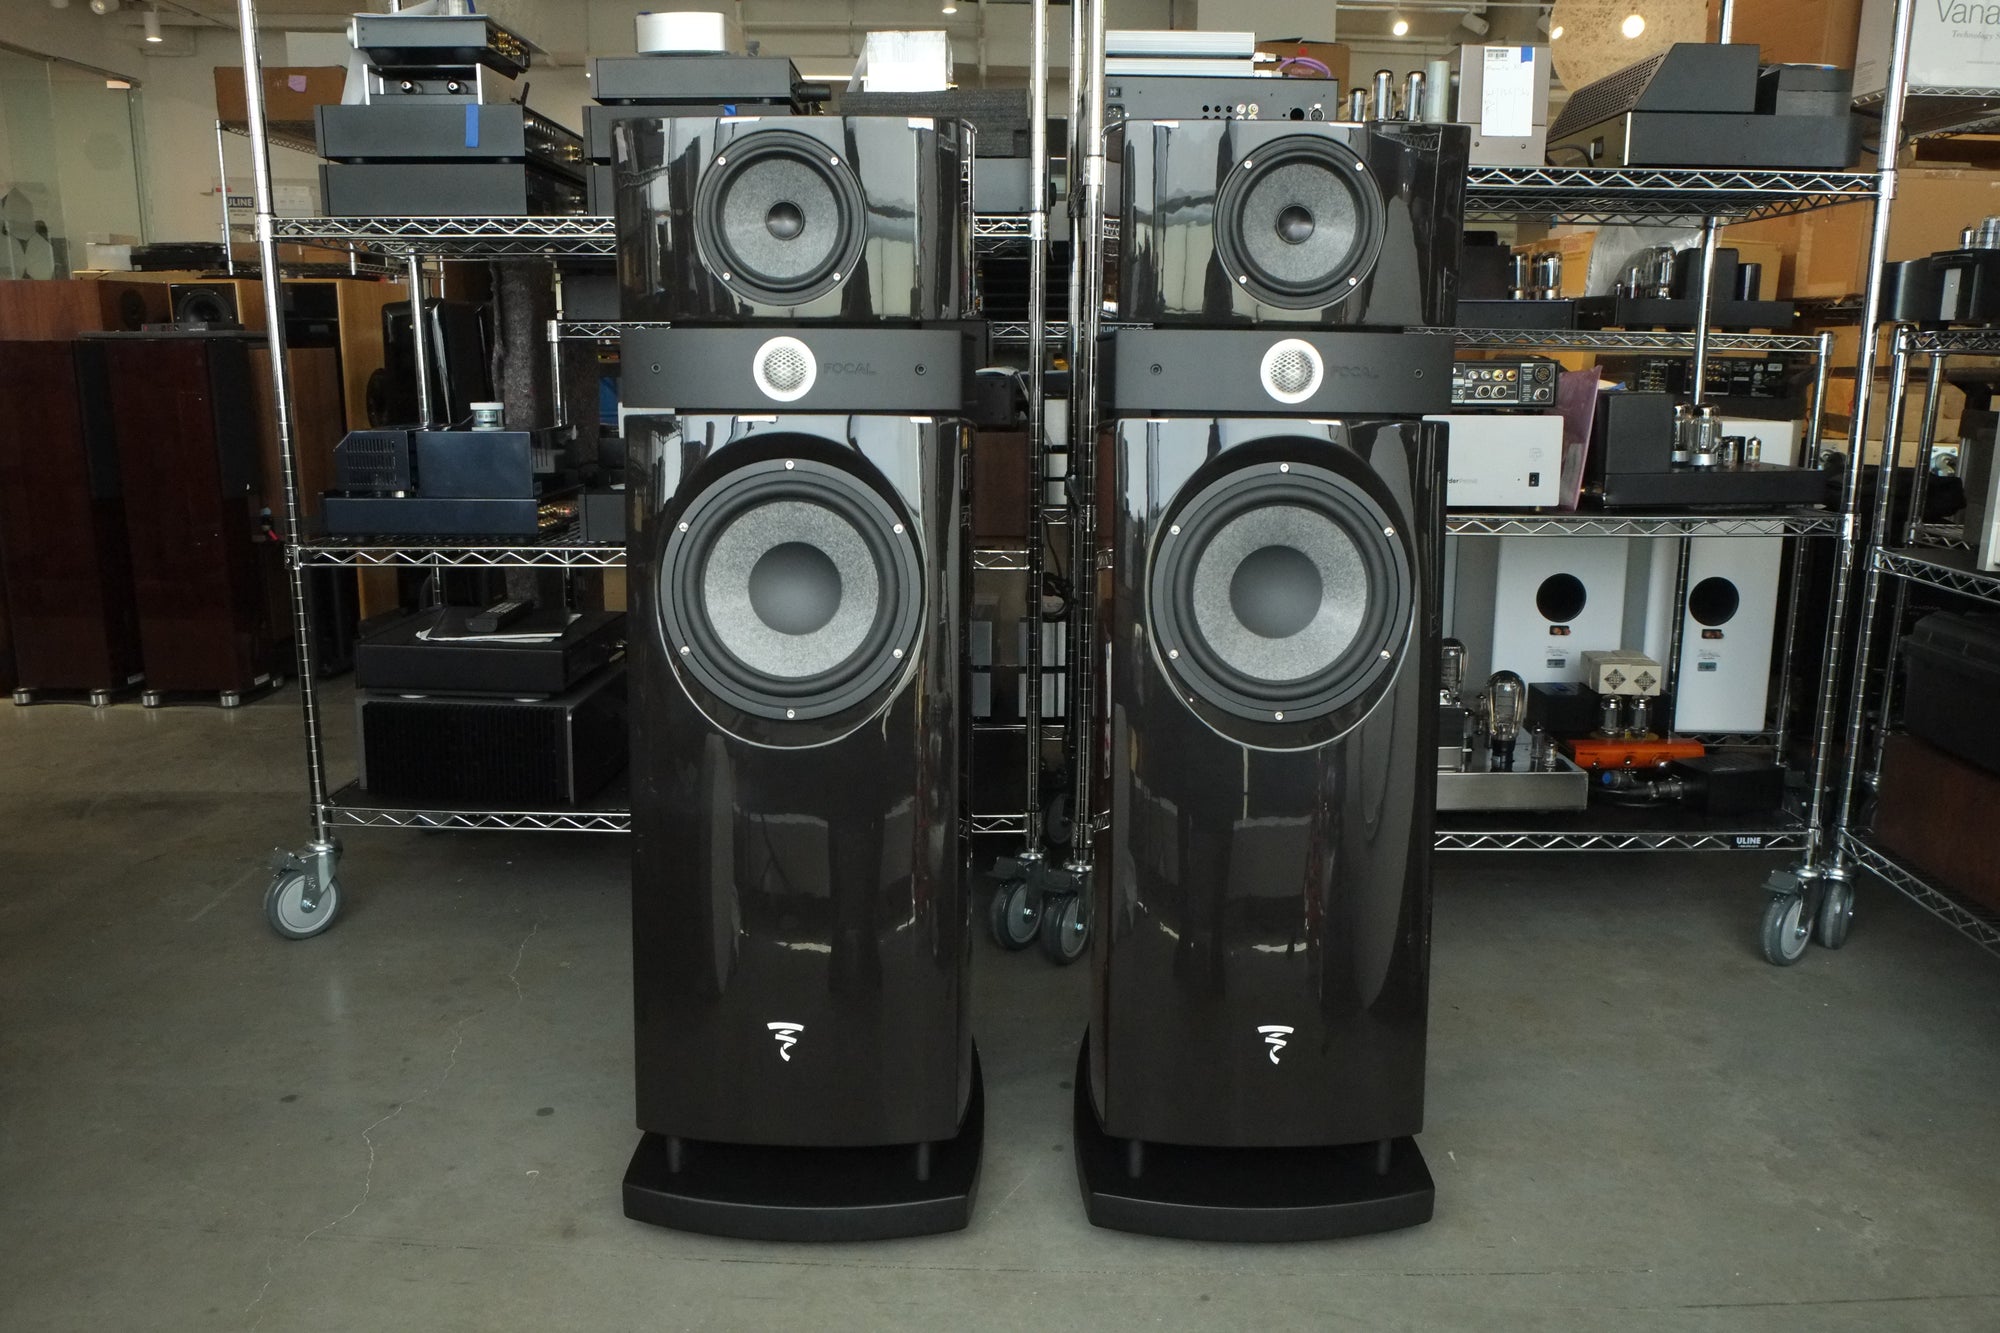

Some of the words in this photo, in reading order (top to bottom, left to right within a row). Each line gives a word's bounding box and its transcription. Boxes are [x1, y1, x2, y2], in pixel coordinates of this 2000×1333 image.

[1952, 30, 1993, 41] Technology
[824, 362, 878, 376] FOCAL
[1736, 836, 1762, 845] ULINE
